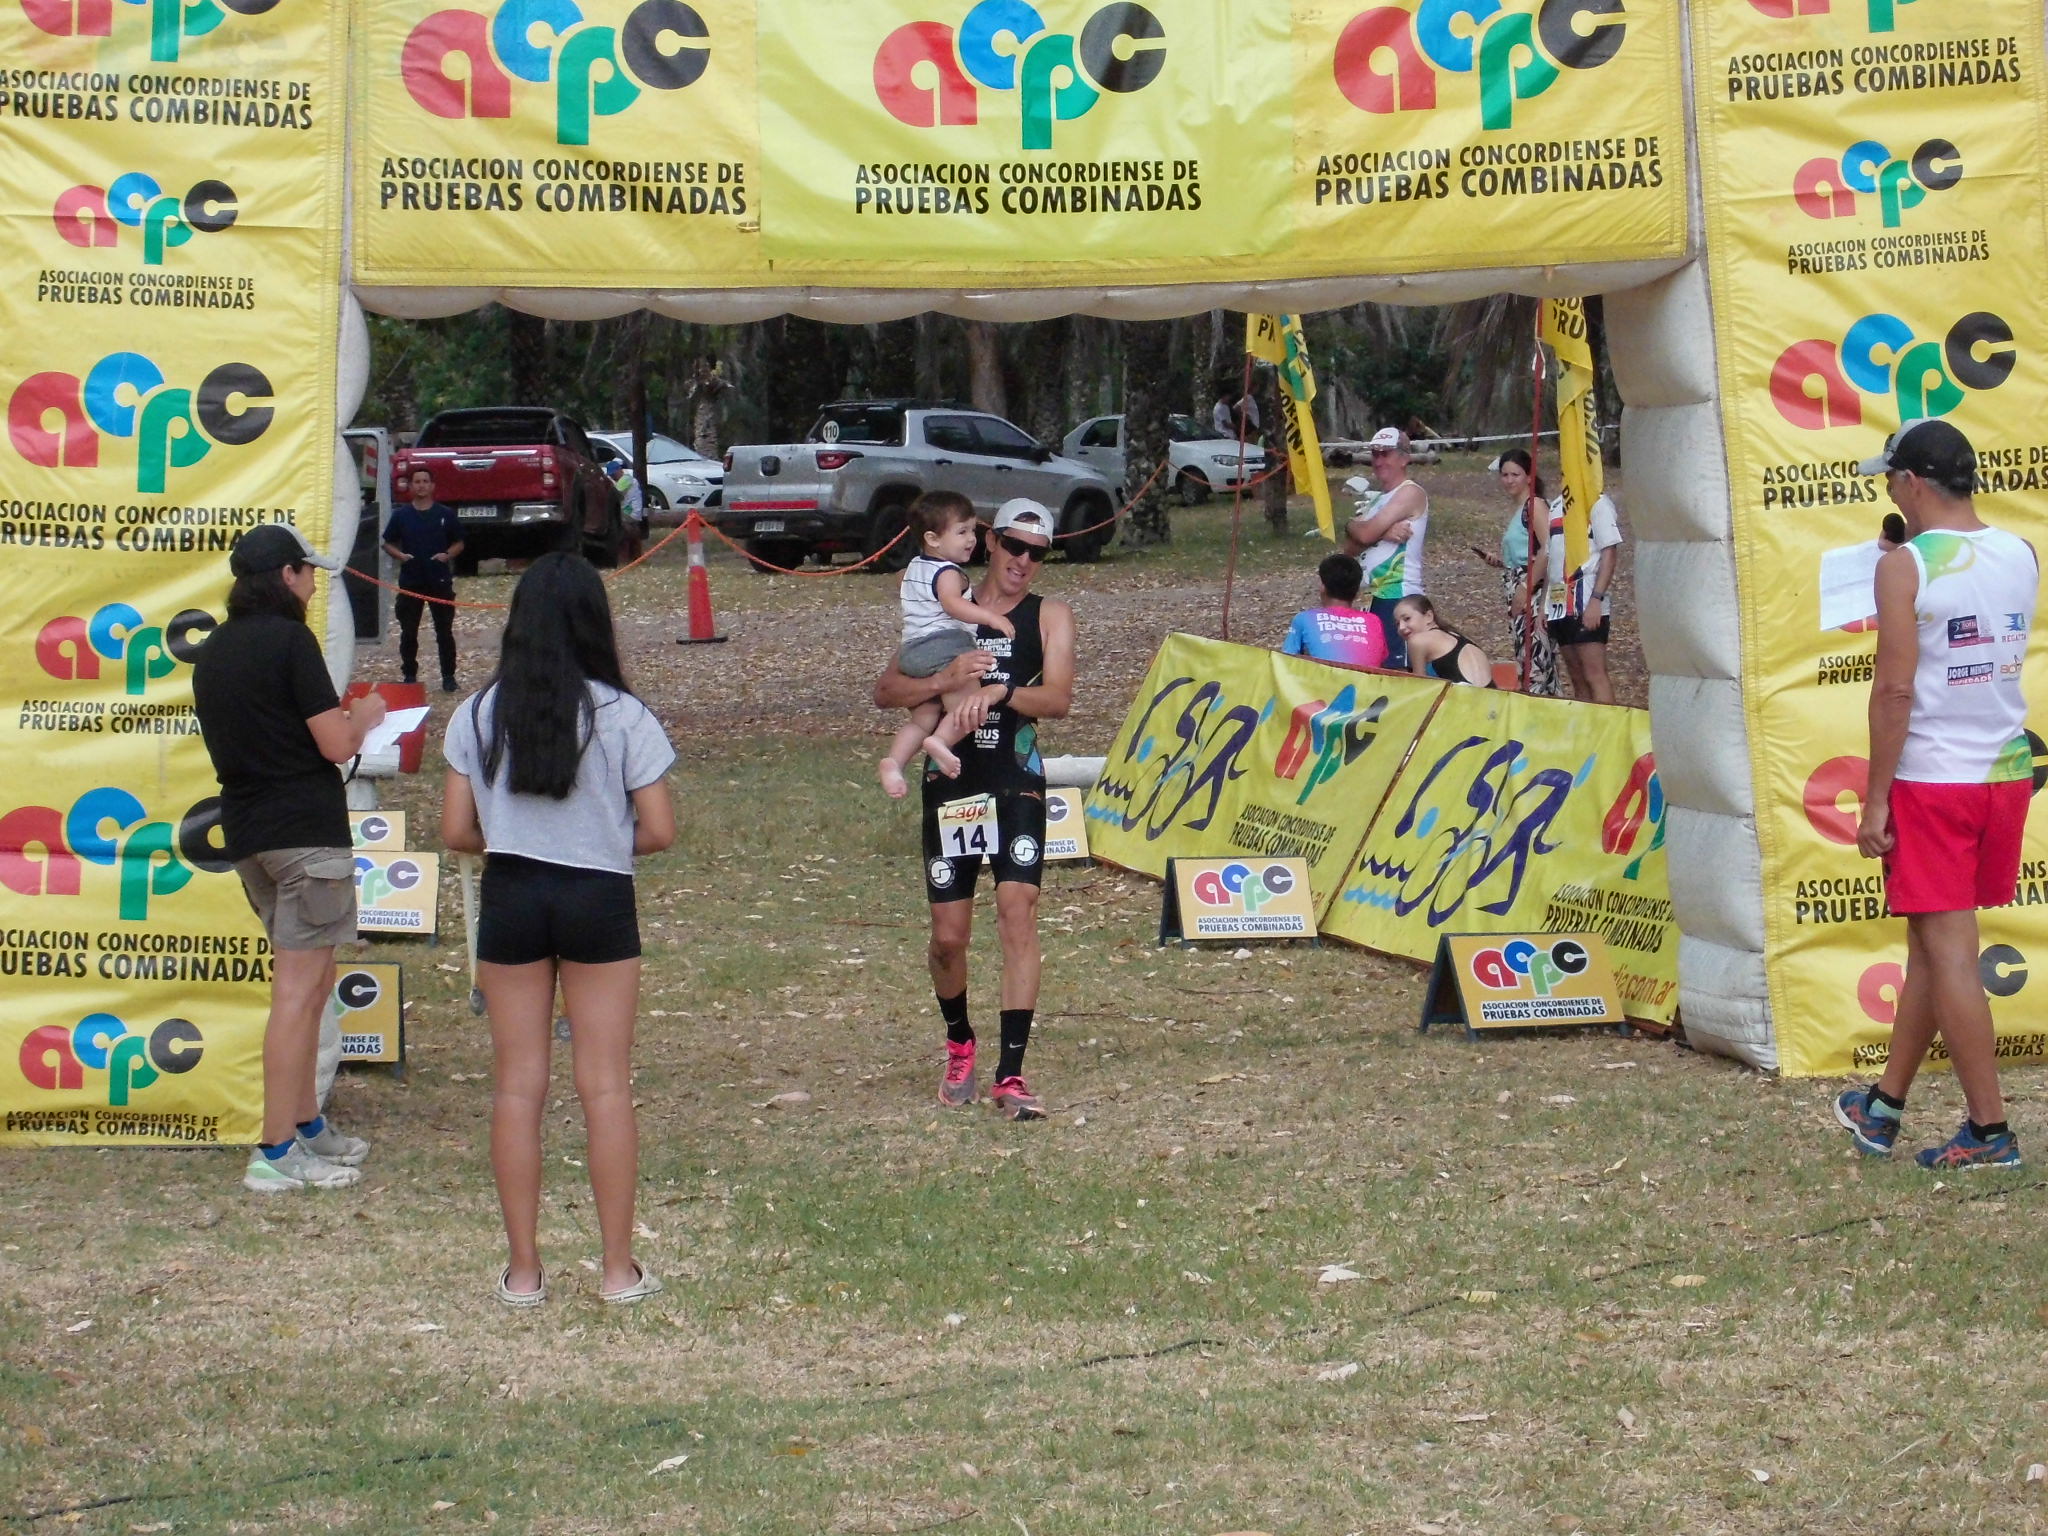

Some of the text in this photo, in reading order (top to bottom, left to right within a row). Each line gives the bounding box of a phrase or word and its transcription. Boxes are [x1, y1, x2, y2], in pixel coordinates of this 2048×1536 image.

[1728, 37, 2017, 74] ASOCIACION CONCORDIENSE DE
[0, 70, 310, 101] ASOCIACION CONCORDIENSE DE
[1728, 57, 2021, 102] PRUEBAS COMBINADAS
[0, 91, 312, 130] PRUEBAS COMBINADAS
[1317, 136, 1659, 175] ASOCIACION CONCORDIENSE DE
[381, 157, 743, 183] ASOCIACION CONCORDIENSE DE
[856, 160, 1198, 184] ASOCIACION CONCORDIENSE DE
[1315, 159, 1663, 206] PRUEBAS COMBINADAS
[380, 182, 747, 215] PRUEBAS COMBINADAS
[856, 183, 1201, 214] PRUEBAS COMBINADAS
[1788, 229, 1987, 258] ASOCIACION CONCORDIENSE DE
[1788, 244, 1989, 275] PRUEBAS COMBINADAS
[39, 270, 254, 291] ASOCIACION CONCORDIENSE DE
[38, 285, 255, 310] PRUEBAS COMBINADAS
[824, 425, 837, 438] 110
[1763, 461, 1860, 485] ASOCIACIO
[1764, 479, 1878, 510] PRUEBAS
[0, 500, 296, 527] SOCIACION CONCORDIENSE DE
[1, 522, 243, 552] RUEBAS COMBINA
[1552, 603, 1563, 618] 70
[1819, 654, 1876, 669] ASOCIACI
[1818, 667, 1873, 685] PRUEB
[21, 699, 196, 717] ASOCIACION CONCORDIEN
[19, 713, 200, 736] PRUEBAS COMBINA
[975, 729, 1000, 740] RUS
[953, 824, 988, 854] 14
[1796, 876, 1881, 898] ASOCIACI
[358, 909, 409, 918] ONCORDIENSE
[358, 917, 420, 927] OMBINADAS
[1199, 922, 1303, 932] PRUEBAS COMBINADAS
[98, 932, 249, 955] CONCORDIENSE
[257, 937, 274, 955] D
[1, 950, 88, 978] UEBAS
[1482, 998, 1602, 1010] ASOCIACION CONCORDIENSE DE
[1484, 1006, 1605, 1020] PRUEBAS COMBINADAS
[369, 1035, 380, 1043] DE
[6, 1119, 218, 1142] PRUEBAS COMBINADAS
[95, 1110, 197, 1127] CONCORDIENSE
[202, 1115, 218, 1127] DE
